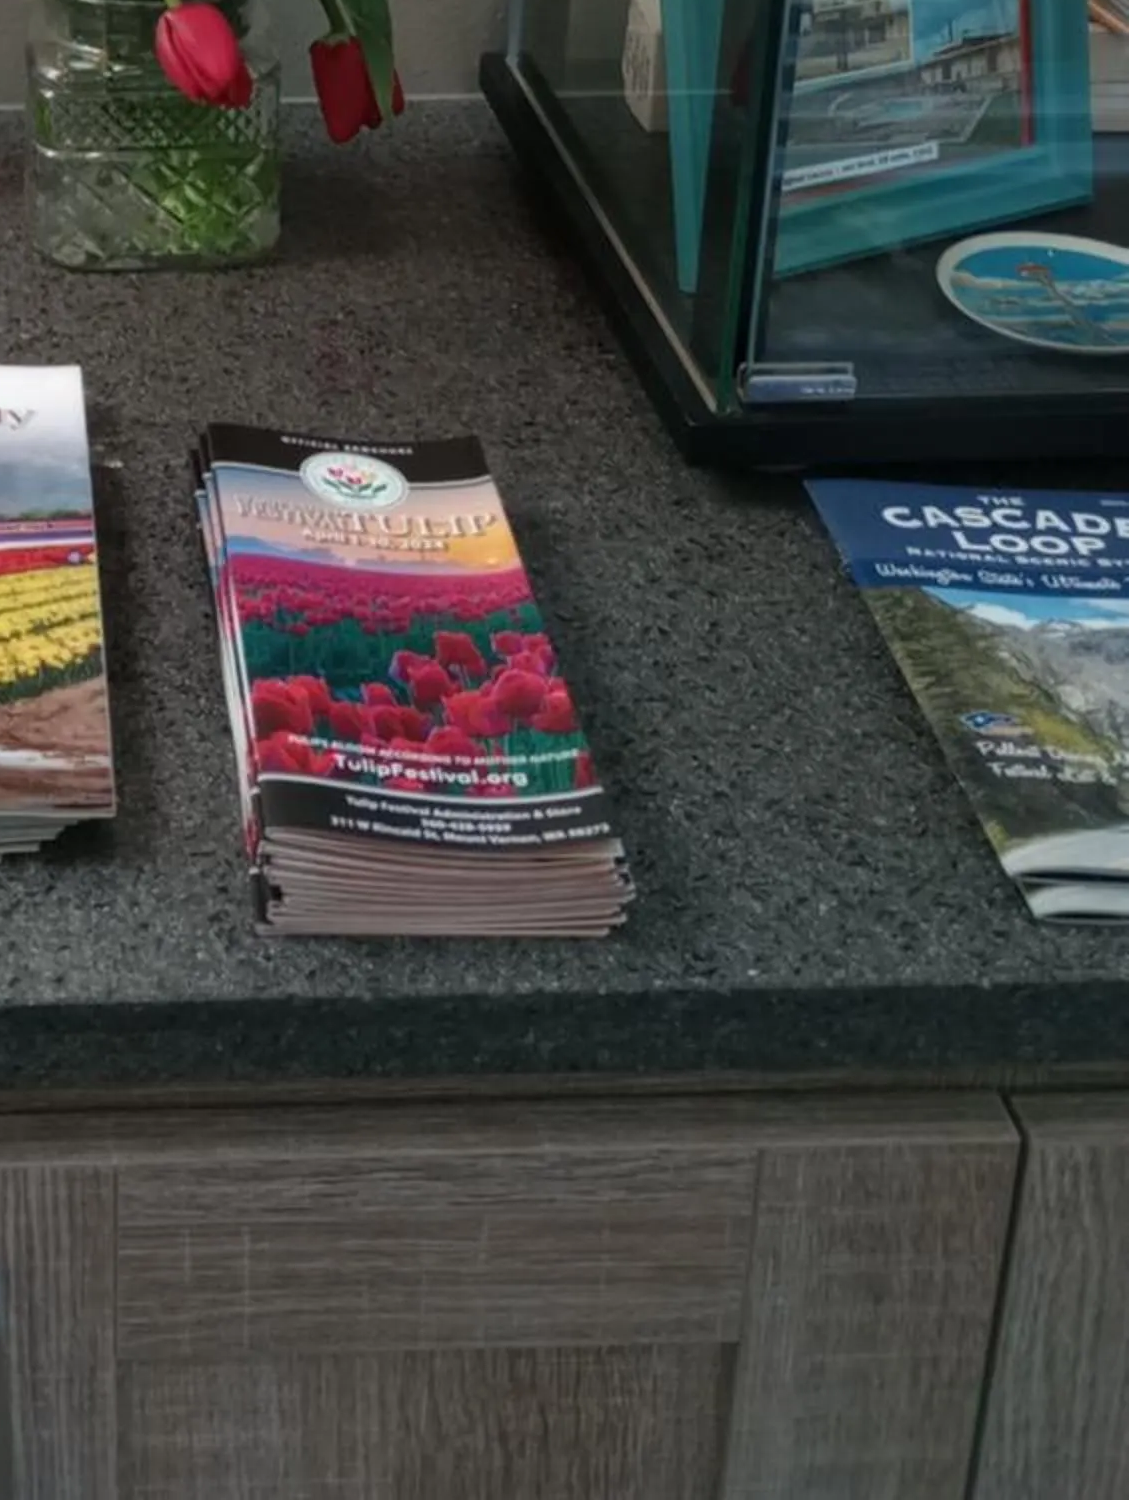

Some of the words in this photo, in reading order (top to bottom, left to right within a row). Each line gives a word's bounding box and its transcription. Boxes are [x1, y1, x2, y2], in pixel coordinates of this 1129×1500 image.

[977, 495, 1025, 507] THE
[345, 508, 497, 538] TULIP
[952, 530, 1106, 556] LOOP
[905, 546, 1011, 564] NATIONAL
[333, 753, 529, 787] TulipFestival.org
[345, 794, 378, 811] Tulip
